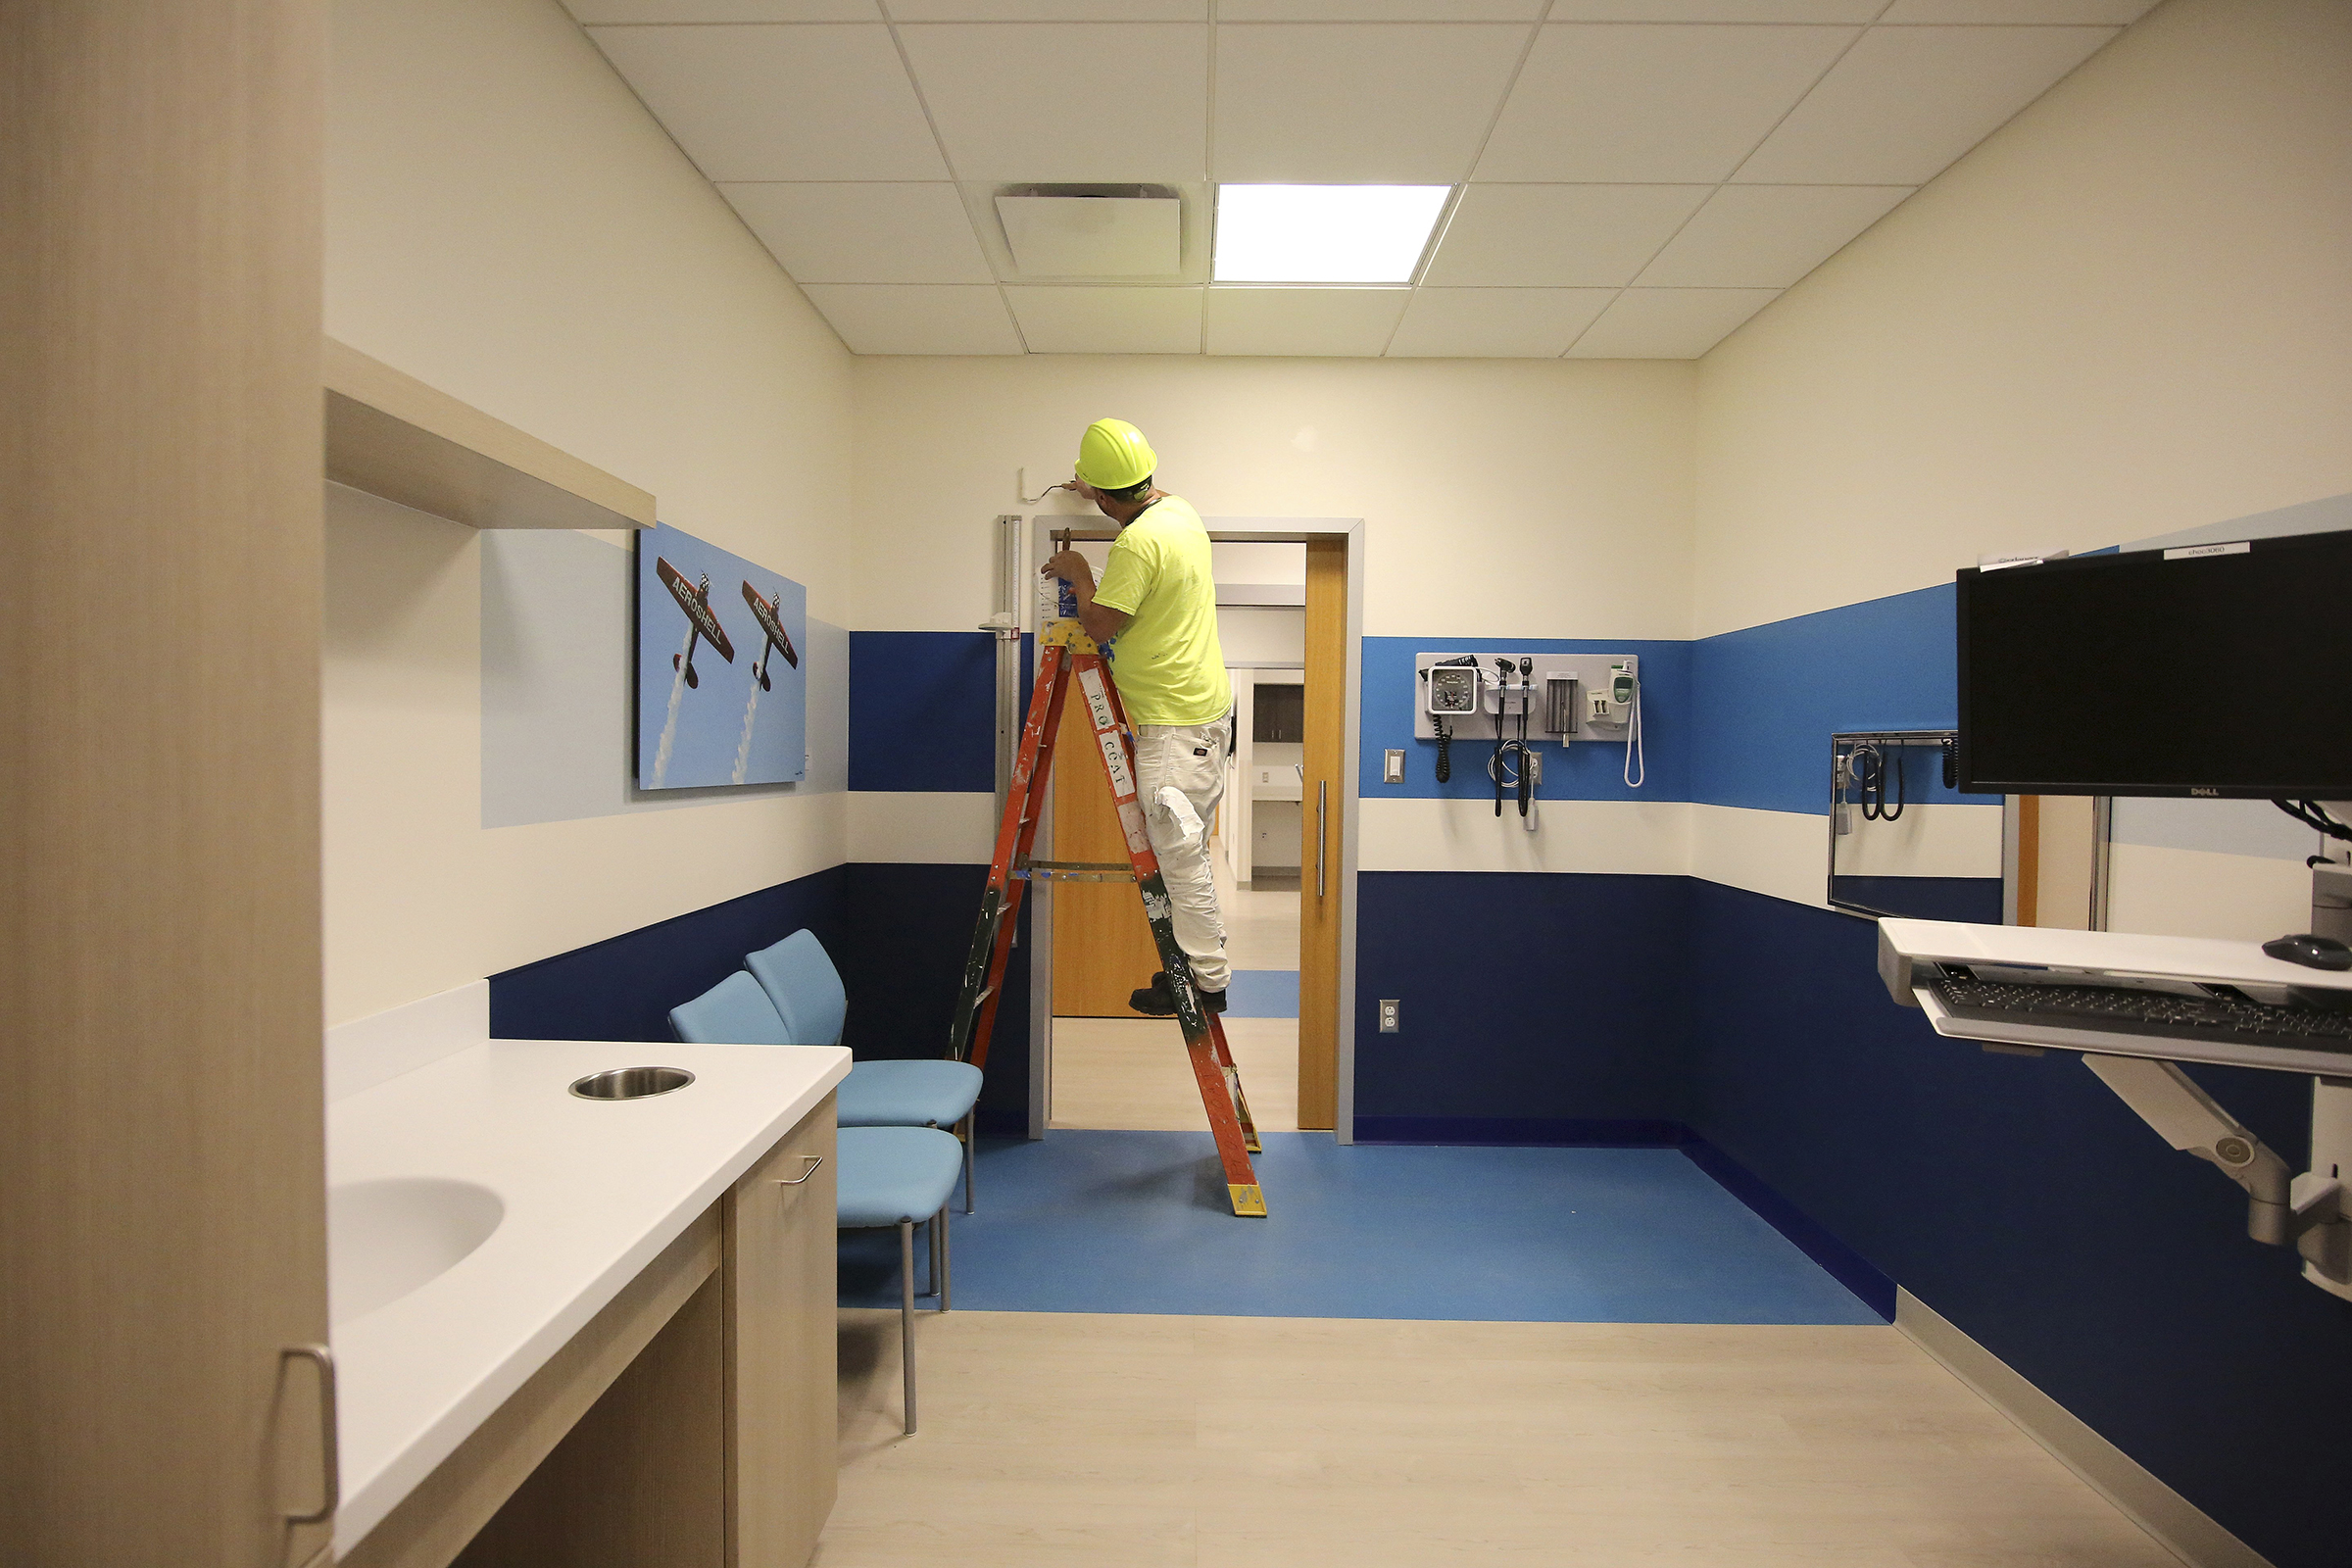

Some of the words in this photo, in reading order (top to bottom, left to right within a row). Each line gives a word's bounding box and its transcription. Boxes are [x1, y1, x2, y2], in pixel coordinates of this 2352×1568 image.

[672, 576, 722, 645] AEROSHELL
[753, 597, 790, 655] AEROSHELL
[1091, 694, 1109, 726] PRO
[1104, 741, 1125, 783] COAT
